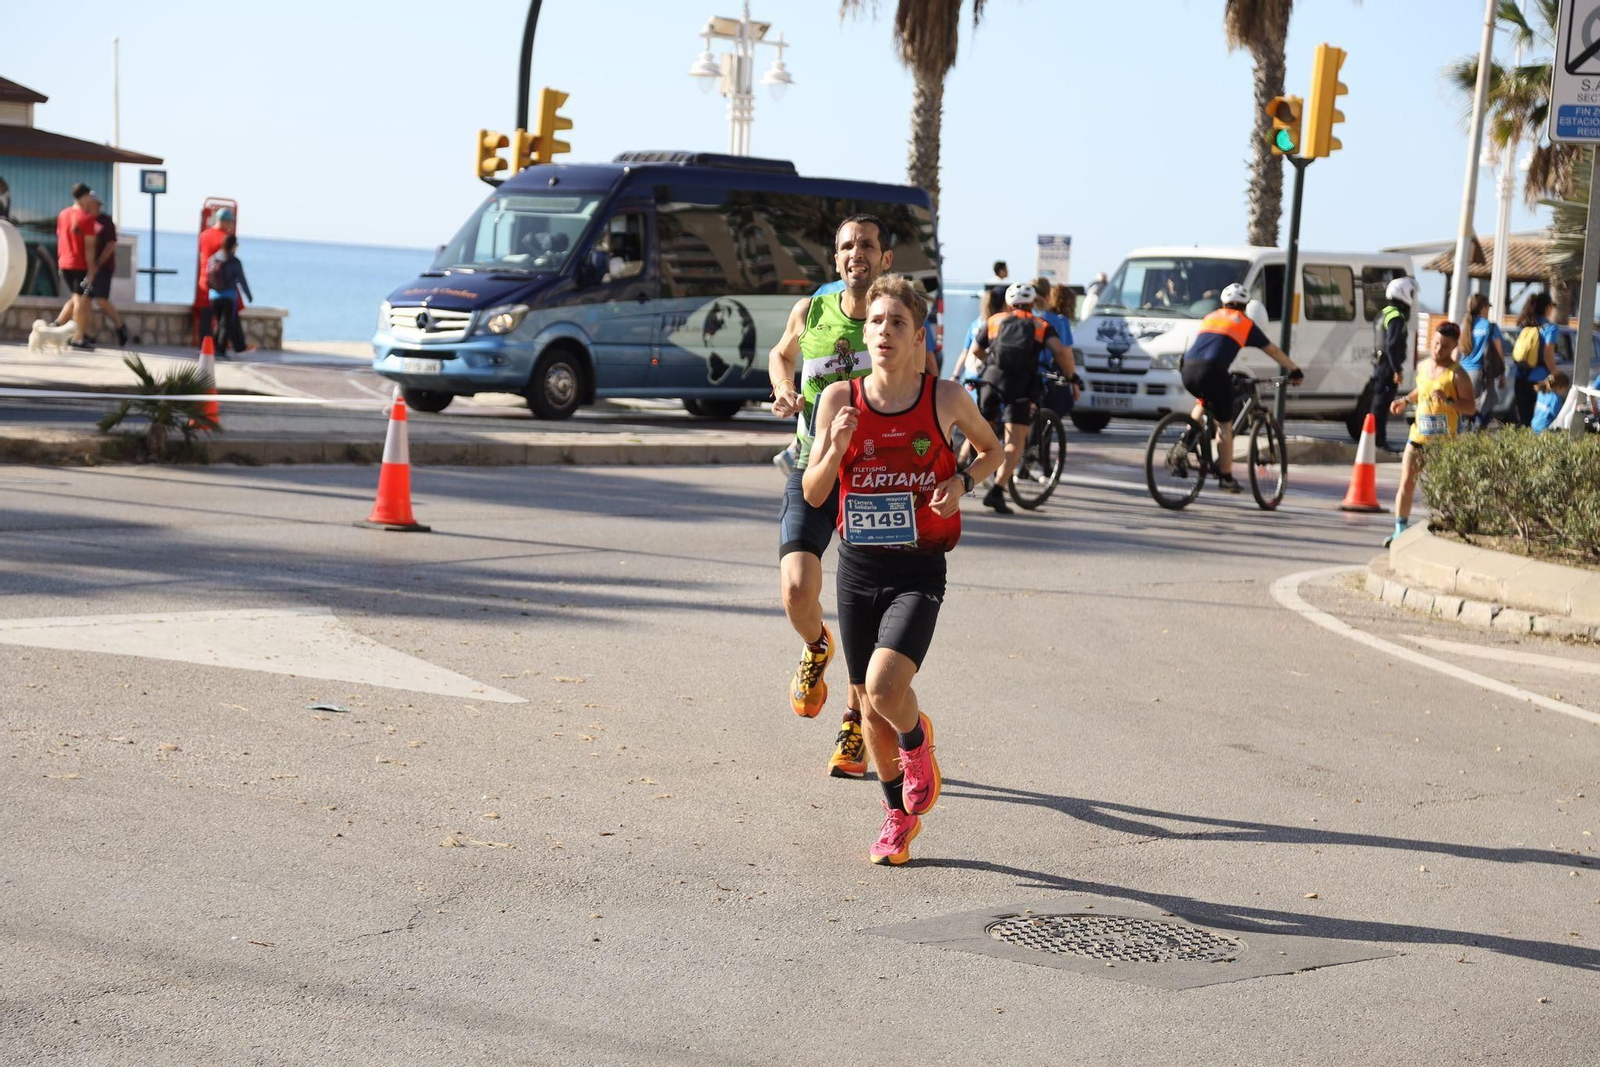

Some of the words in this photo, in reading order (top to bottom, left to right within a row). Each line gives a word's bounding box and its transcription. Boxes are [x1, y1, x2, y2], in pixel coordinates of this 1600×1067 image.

[1577, 93, 1600, 103] SEC
[1576, 107, 1591, 116] FIN
[851, 512, 906, 528] 2149
